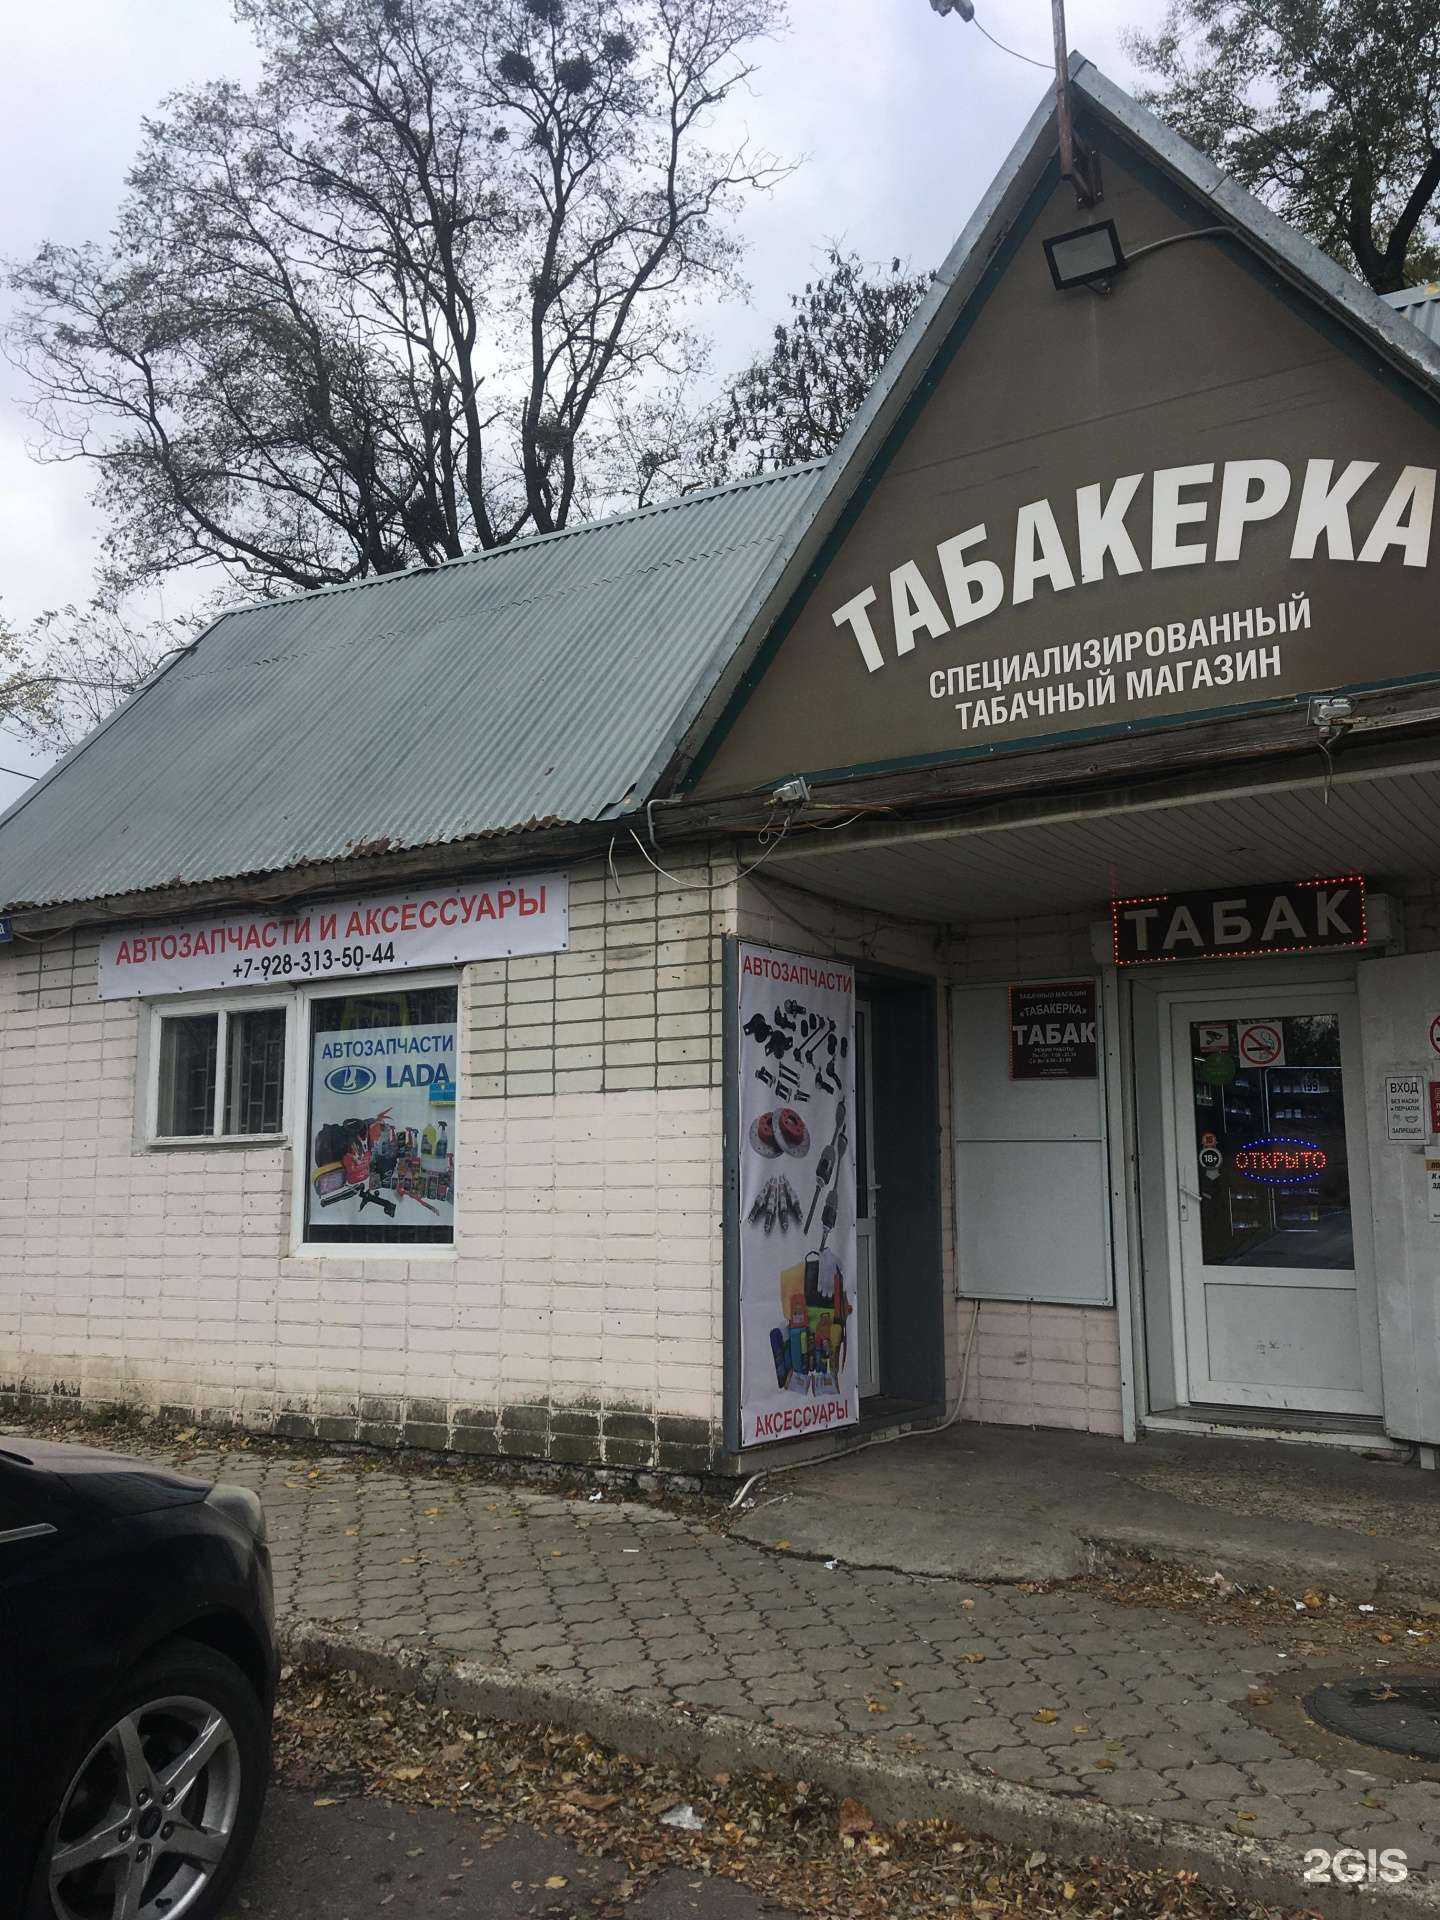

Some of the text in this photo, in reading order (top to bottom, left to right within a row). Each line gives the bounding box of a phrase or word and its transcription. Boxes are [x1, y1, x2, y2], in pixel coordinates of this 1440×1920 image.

[831, 458, 1438, 673] ТАБАКЕРКА
[929, 592, 1312, 699] СПЕЦИАЛИЗИРОВАННЫЙ
[955, 646, 1282, 730] ТАБАЧНЫЙ МАГАЗИН
[116, 886, 547, 966] АВТОЗАПЧАСТИ И АКСЕССУАРЫ
[1123, 889, 1352, 951] ТАБАК
[233, 942, 395, 979] +7-928-313-50-44
[743, 956, 853, 993] АВТОЗАПЧАСТИ
[1020, 1002, 1087, 1017] «ТАБАКЕРКА»
[322, 1034, 454, 1060] АВТОЗАПЧАСТИ
[1012, 1022, 1096, 1046] ТАБАК
[386, 1063, 450, 1089] LADA
[1390, 1081, 1419, 1094] ВХОД
[1203, 1153, 1218, 1163] 18+
[1236, 1151, 1328, 1169] ОТКРЫТО
[755, 1399, 849, 1438] АКСЕССУАРЫ
